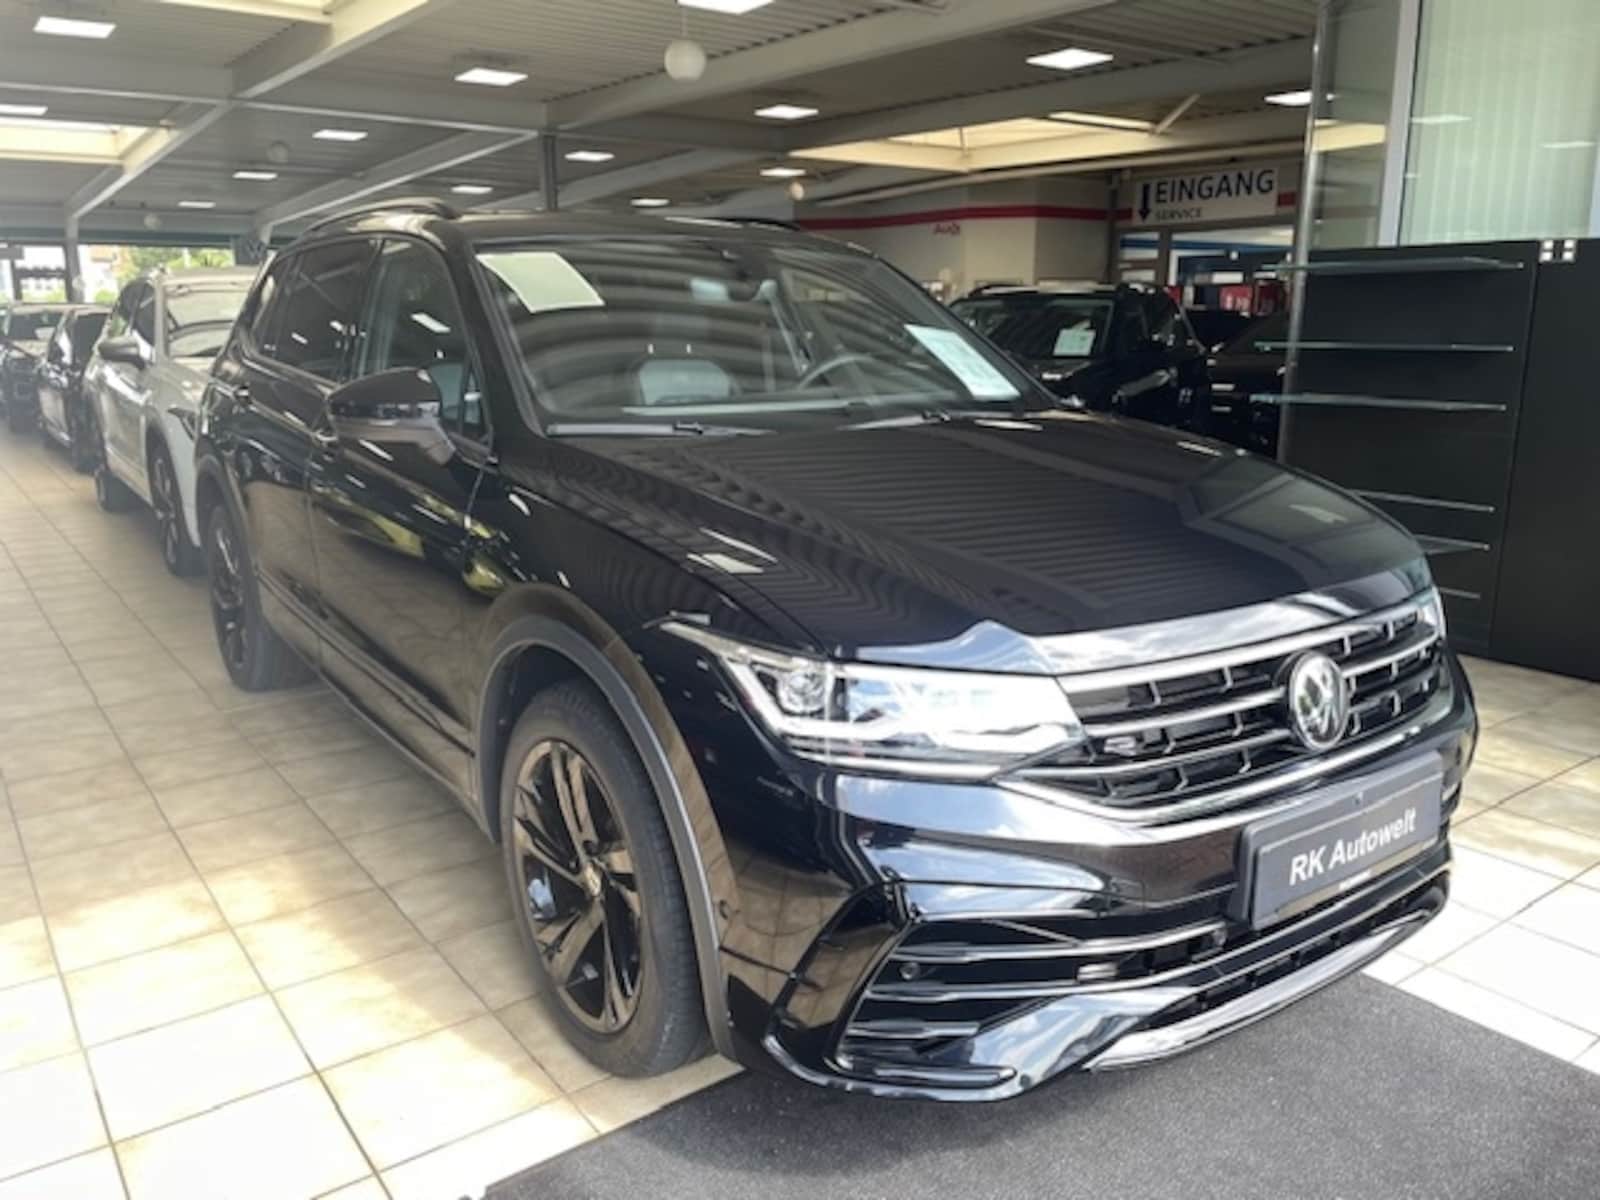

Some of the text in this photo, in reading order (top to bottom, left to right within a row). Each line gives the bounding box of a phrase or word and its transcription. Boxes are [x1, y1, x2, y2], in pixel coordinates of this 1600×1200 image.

[1155, 169, 1274, 203] EINGANG
[1289, 845, 1327, 886] RK
[1328, 807, 1416, 869] Autowelt
